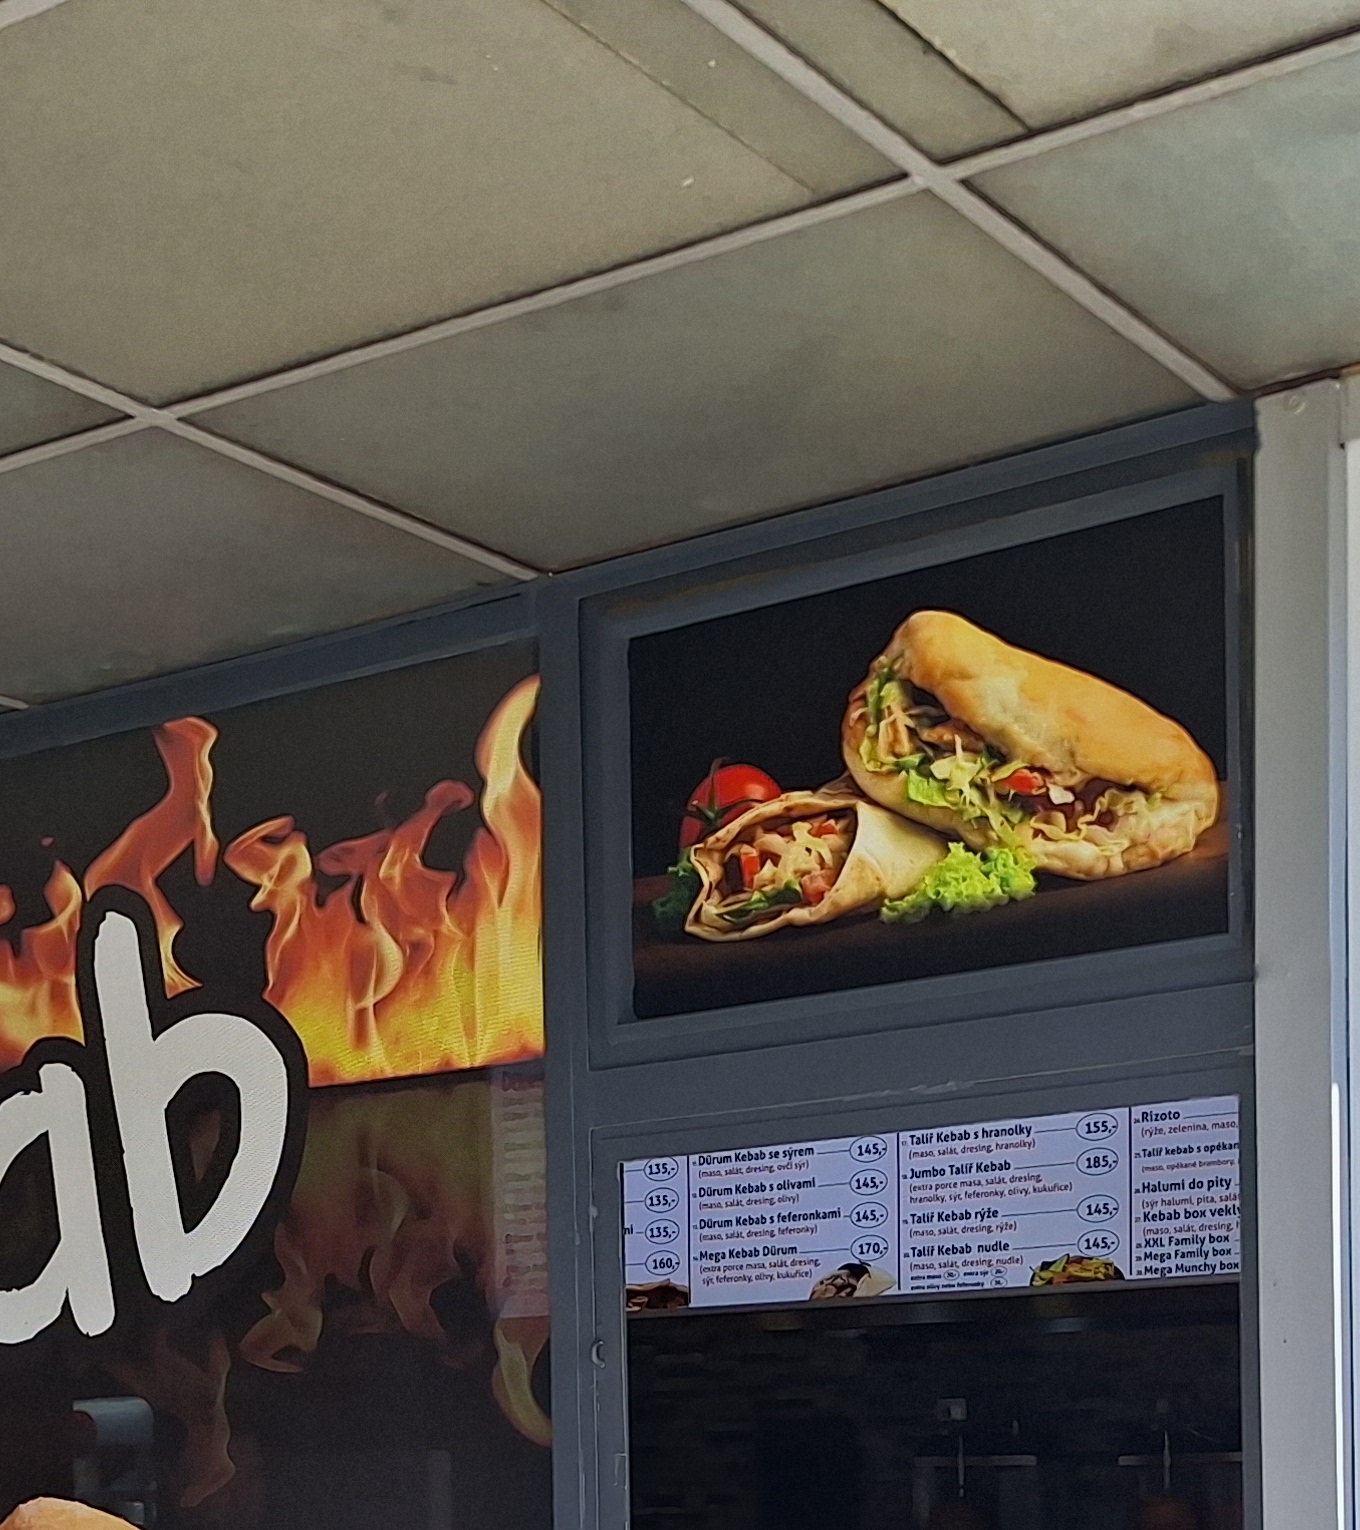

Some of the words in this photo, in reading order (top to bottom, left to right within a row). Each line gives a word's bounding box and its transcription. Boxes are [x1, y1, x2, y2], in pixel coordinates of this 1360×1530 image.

[1142, 1111, 1180, 1123] Rizoto
[909, 1133, 934, 1145] Talíř
[937, 1130, 970, 1143] Kebab
[982, 1124, 1032, 1138] hranolky
[910, 1166, 945, 1179] Jumbo
[976, 1160, 1011, 1173] Kebab
[1142, 1179, 1185, 1193] Halumi
[1189, 1178, 1203, 1190] do
[1207, 1176, 1231, 1191] pity
[736, 1212, 766, 1226] Kebab
[777, 1208, 841, 1223] feferonkami
[910, 1212, 934, 1224] Talíř
[938, 1209, 971, 1222] Kebab
[975, 1208, 999, 1221] rýže
[1144, 1237, 1165, 1248] XXL
[1168, 1234, 1205, 1248] Family
[1209, 1233, 1230, 1243] box
